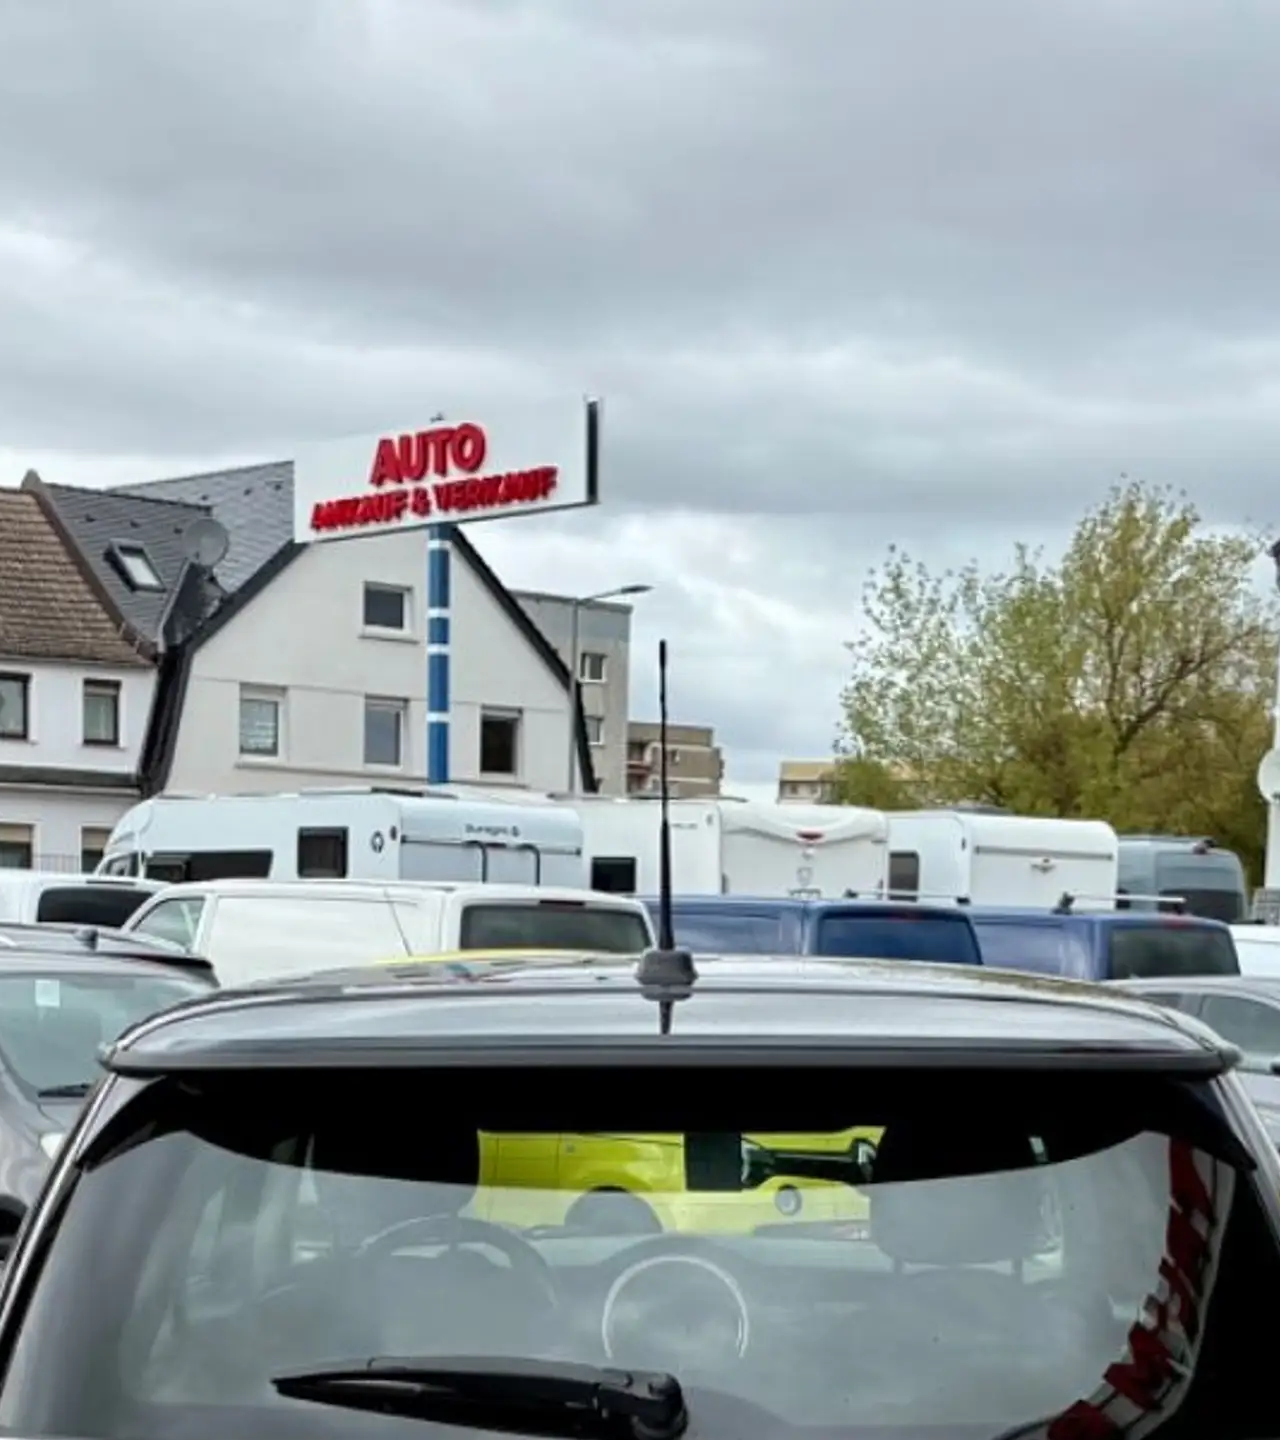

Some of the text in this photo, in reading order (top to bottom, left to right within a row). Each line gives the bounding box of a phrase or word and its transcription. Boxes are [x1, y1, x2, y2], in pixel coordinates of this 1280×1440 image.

[370, 423, 486, 487] AUTO
[310, 466, 558, 530] ANKAUF & VERKAUF
